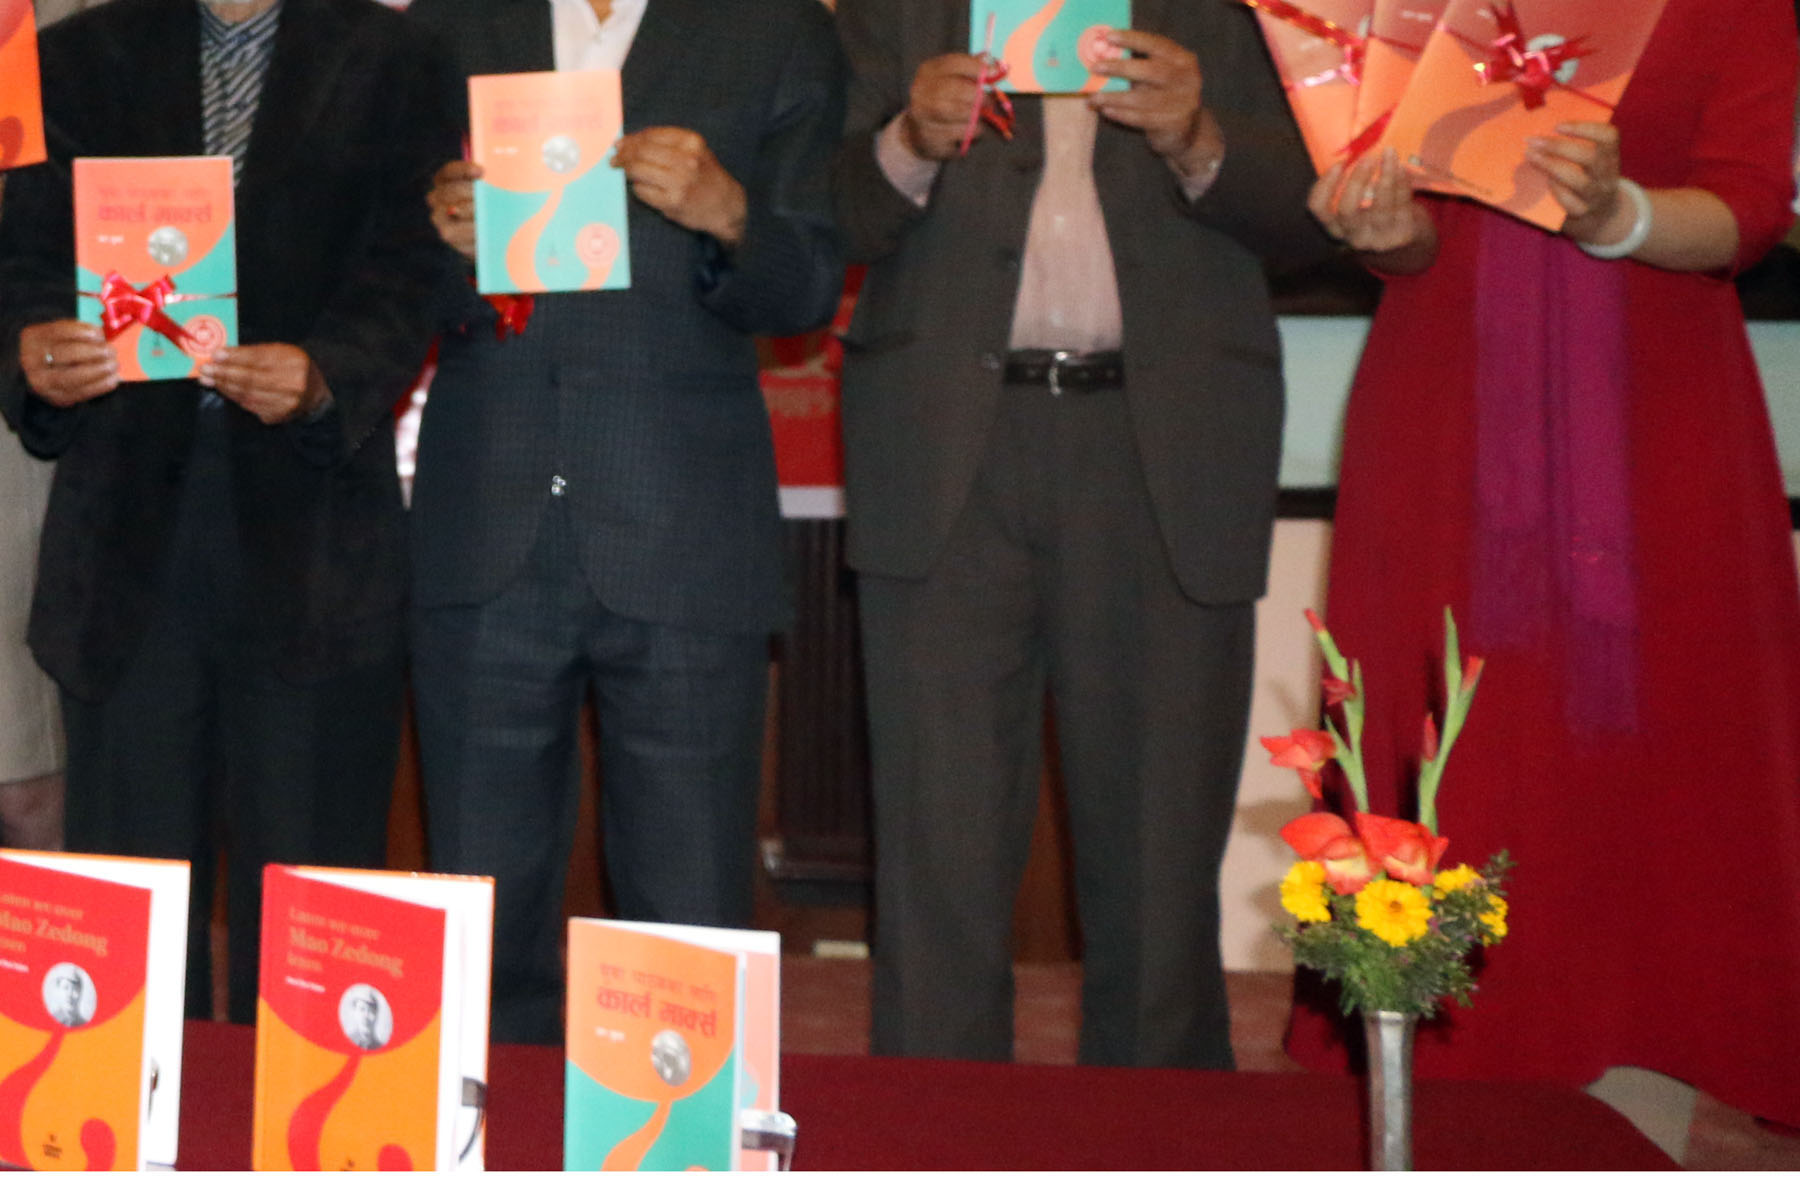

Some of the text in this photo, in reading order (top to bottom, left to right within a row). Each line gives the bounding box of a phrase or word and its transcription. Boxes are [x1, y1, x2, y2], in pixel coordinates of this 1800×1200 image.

[35, 917, 109, 958] Zedong
[288, 924, 405, 979] Mao Zedong
